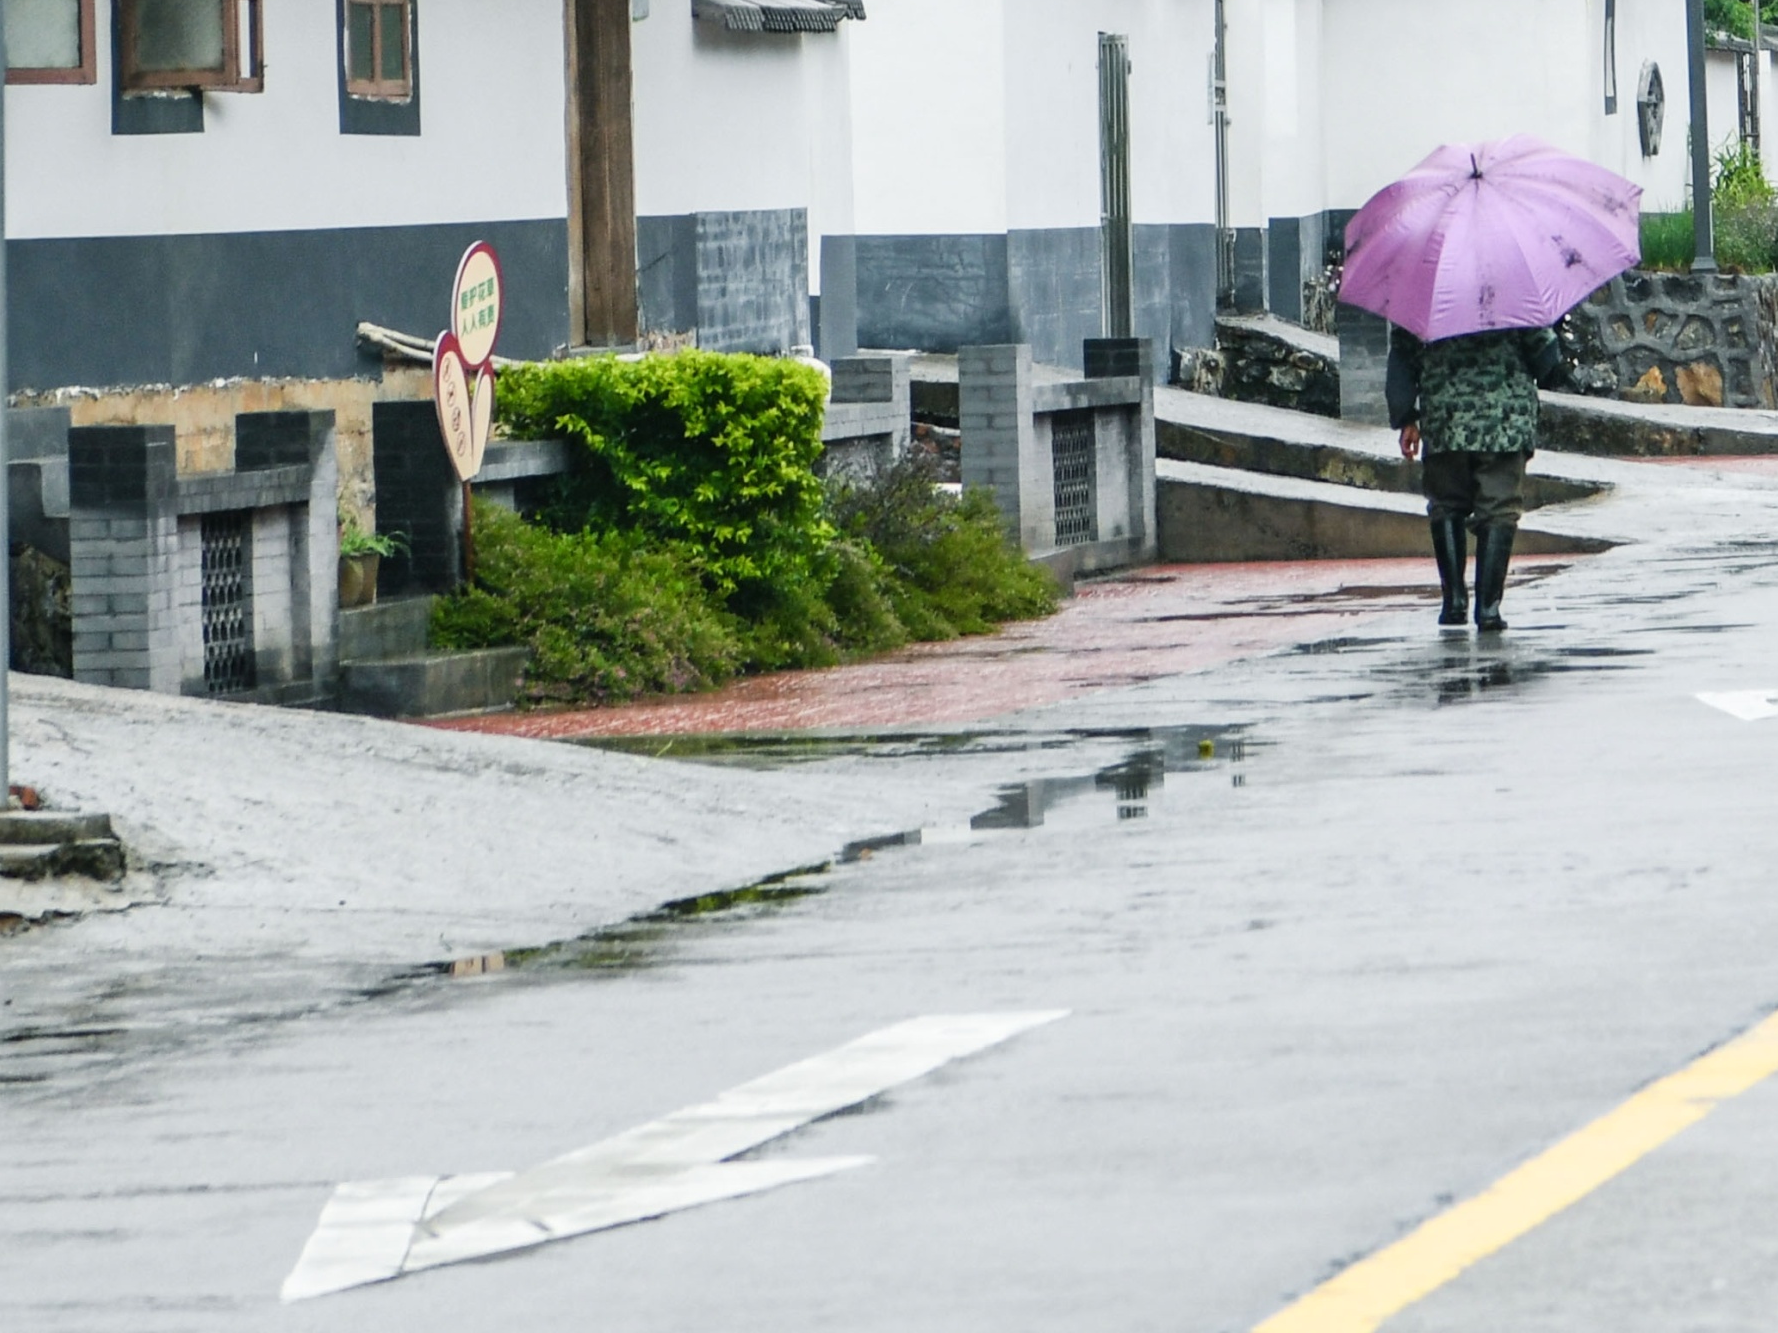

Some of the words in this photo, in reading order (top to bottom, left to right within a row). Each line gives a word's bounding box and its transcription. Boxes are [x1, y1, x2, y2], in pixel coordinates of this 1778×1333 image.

[461, 277, 494, 310] 爱护花草
[461, 304, 495, 337] 人人有责
